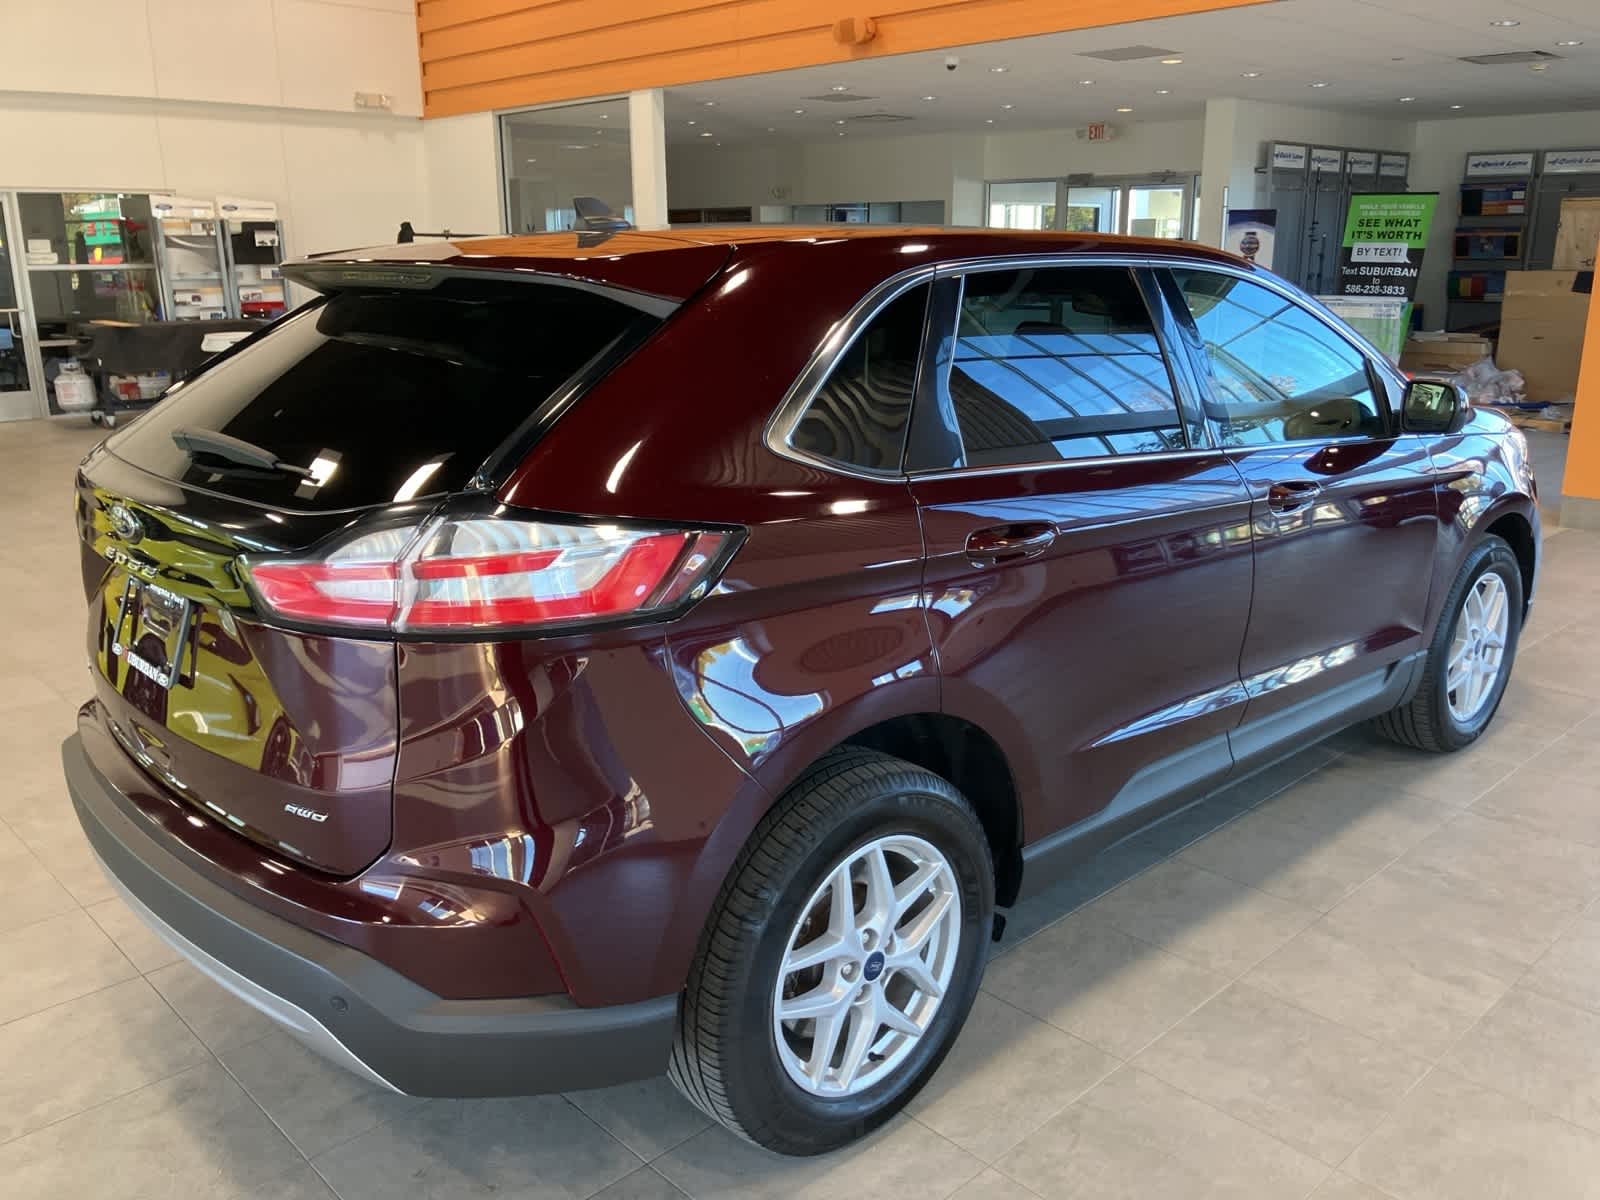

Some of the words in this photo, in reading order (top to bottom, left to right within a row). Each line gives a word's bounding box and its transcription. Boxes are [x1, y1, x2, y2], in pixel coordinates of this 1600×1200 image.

[1358, 218, 1380, 228] SEE
[1384, 218, 1422, 228] WHAT
[1351, 230, 1374, 239] IT'S
[1377, 231, 1422, 240] WORTH
[1356, 247, 1372, 256] BY
[1374, 248, 1402, 257] TEXT!
[1341, 266, 1358, 275] Text
[1359, 266, 1418, 277] SUBURBAN
[1372, 277, 1381, 285] to
